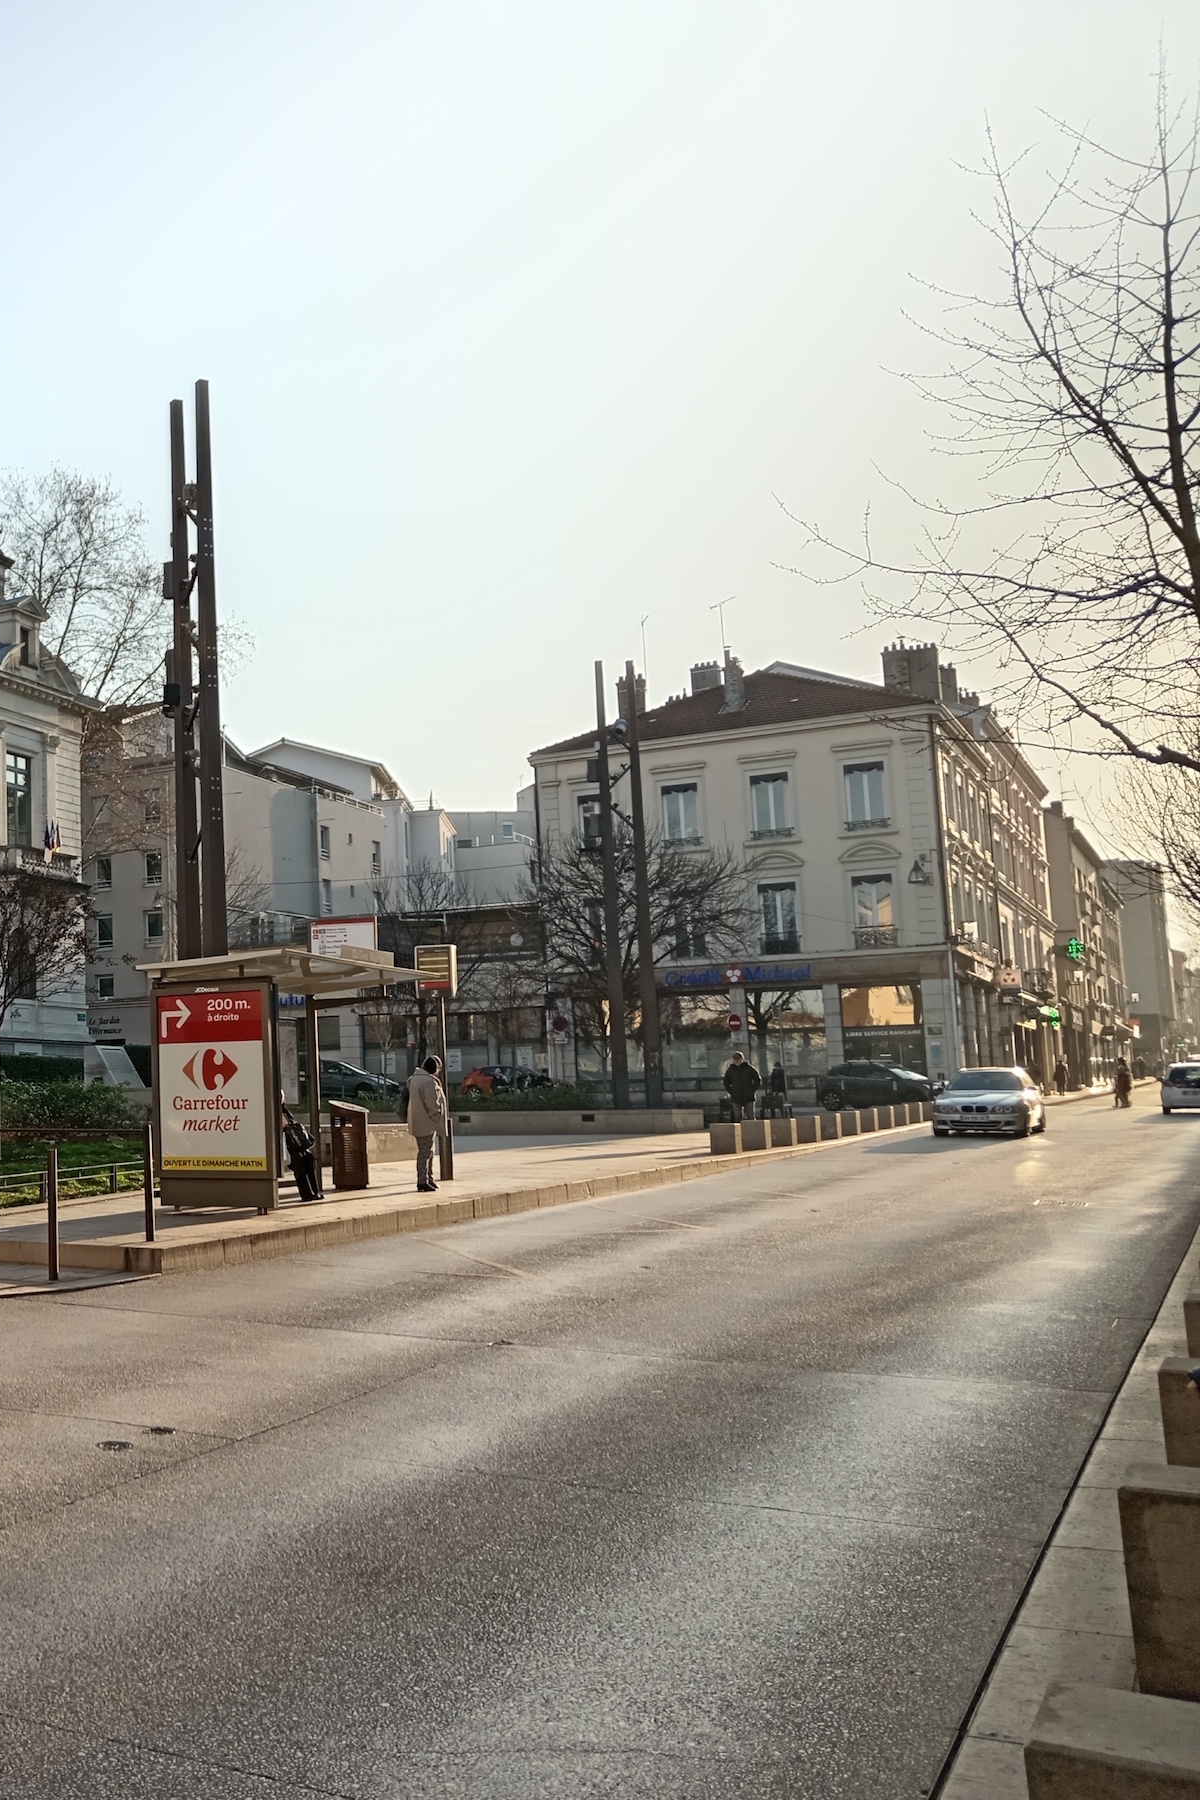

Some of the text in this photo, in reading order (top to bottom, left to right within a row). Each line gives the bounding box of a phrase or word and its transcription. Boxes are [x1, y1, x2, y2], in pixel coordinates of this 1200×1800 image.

[745, 963, 811, 981] Mutuel
[207, 998, 251, 1011] 200 m.
[207, 1012, 239, 1022] à droite
[173, 1094, 248, 1110] Carrefour
[182, 1115, 240, 1133] market
